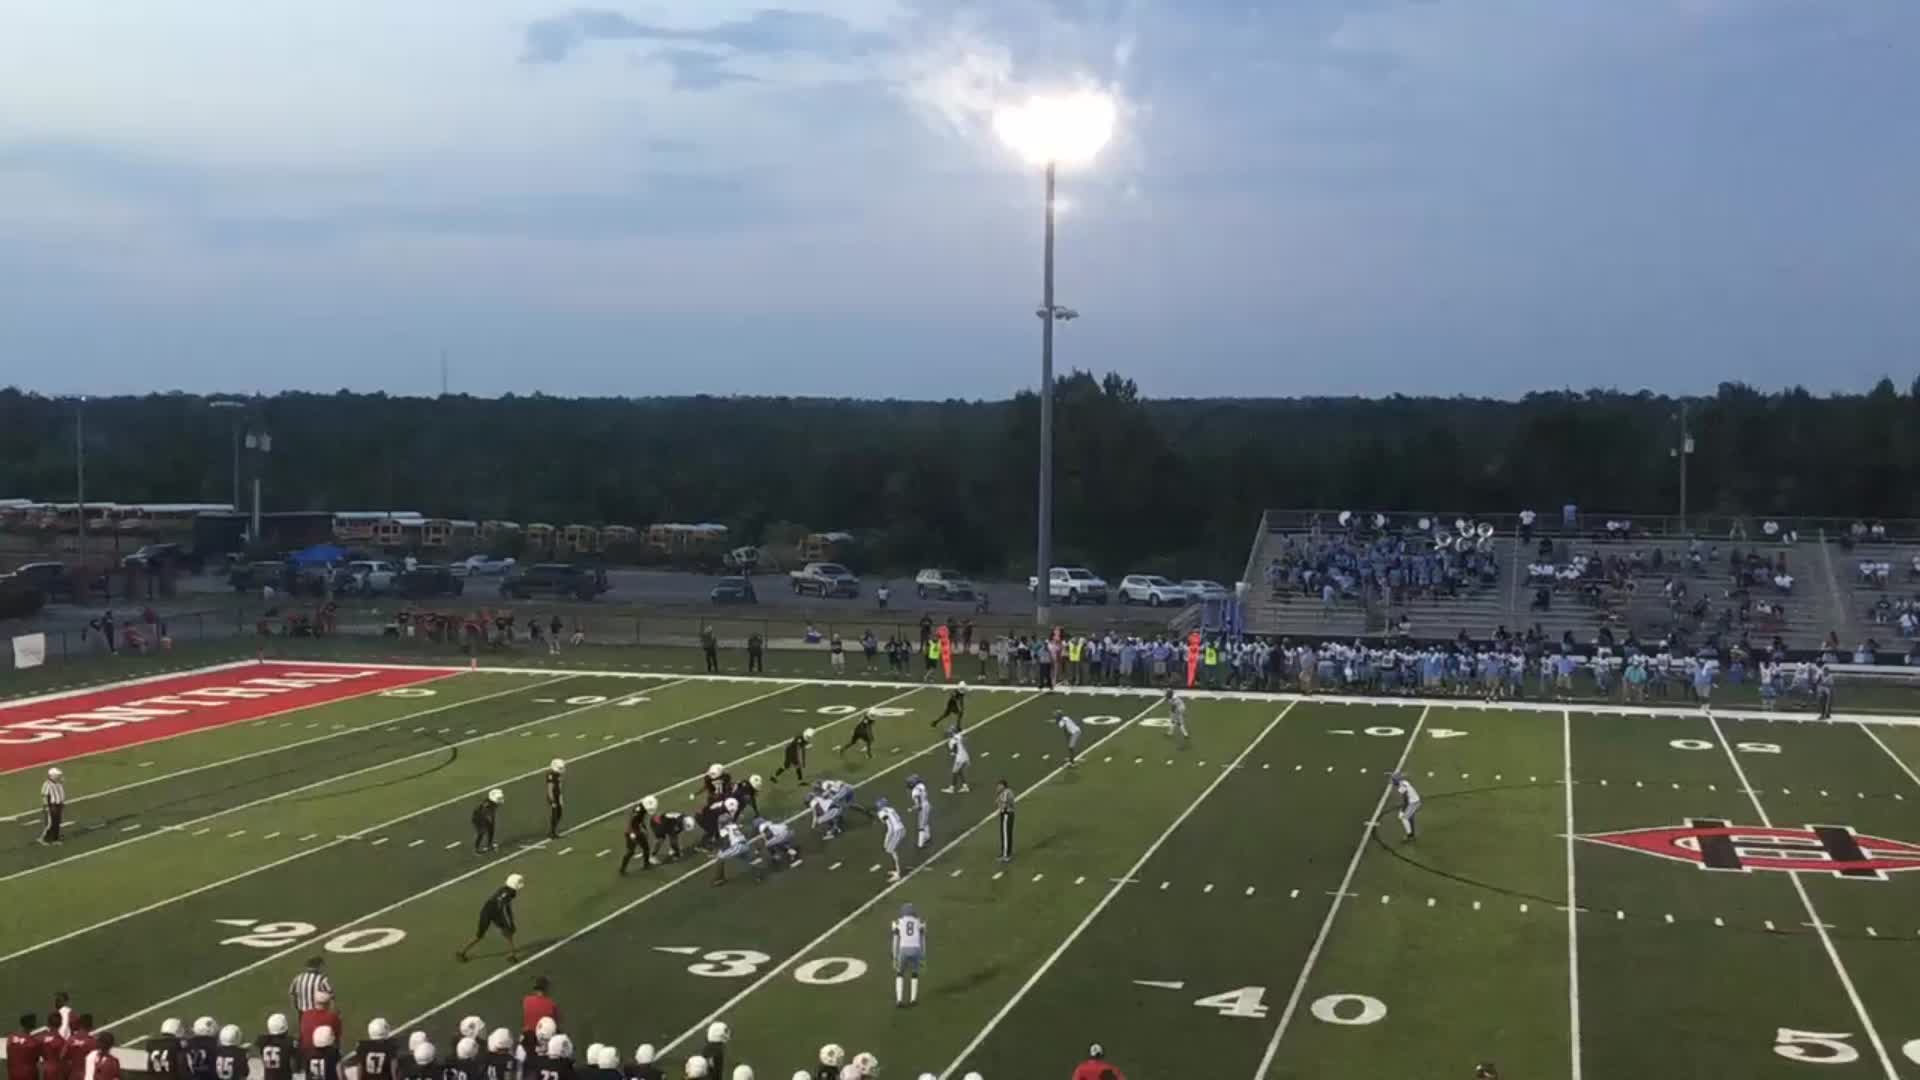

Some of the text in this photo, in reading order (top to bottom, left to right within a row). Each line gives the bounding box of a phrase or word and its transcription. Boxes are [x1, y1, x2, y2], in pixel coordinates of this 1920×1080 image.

[0, 671, 379, 744] CENTRAL
[220, 922, 407, 953] 20
[906, 920, 915, 937] 8
[687, 950, 868, 985] 30
[1193, 986, 1388, 1026] 40
